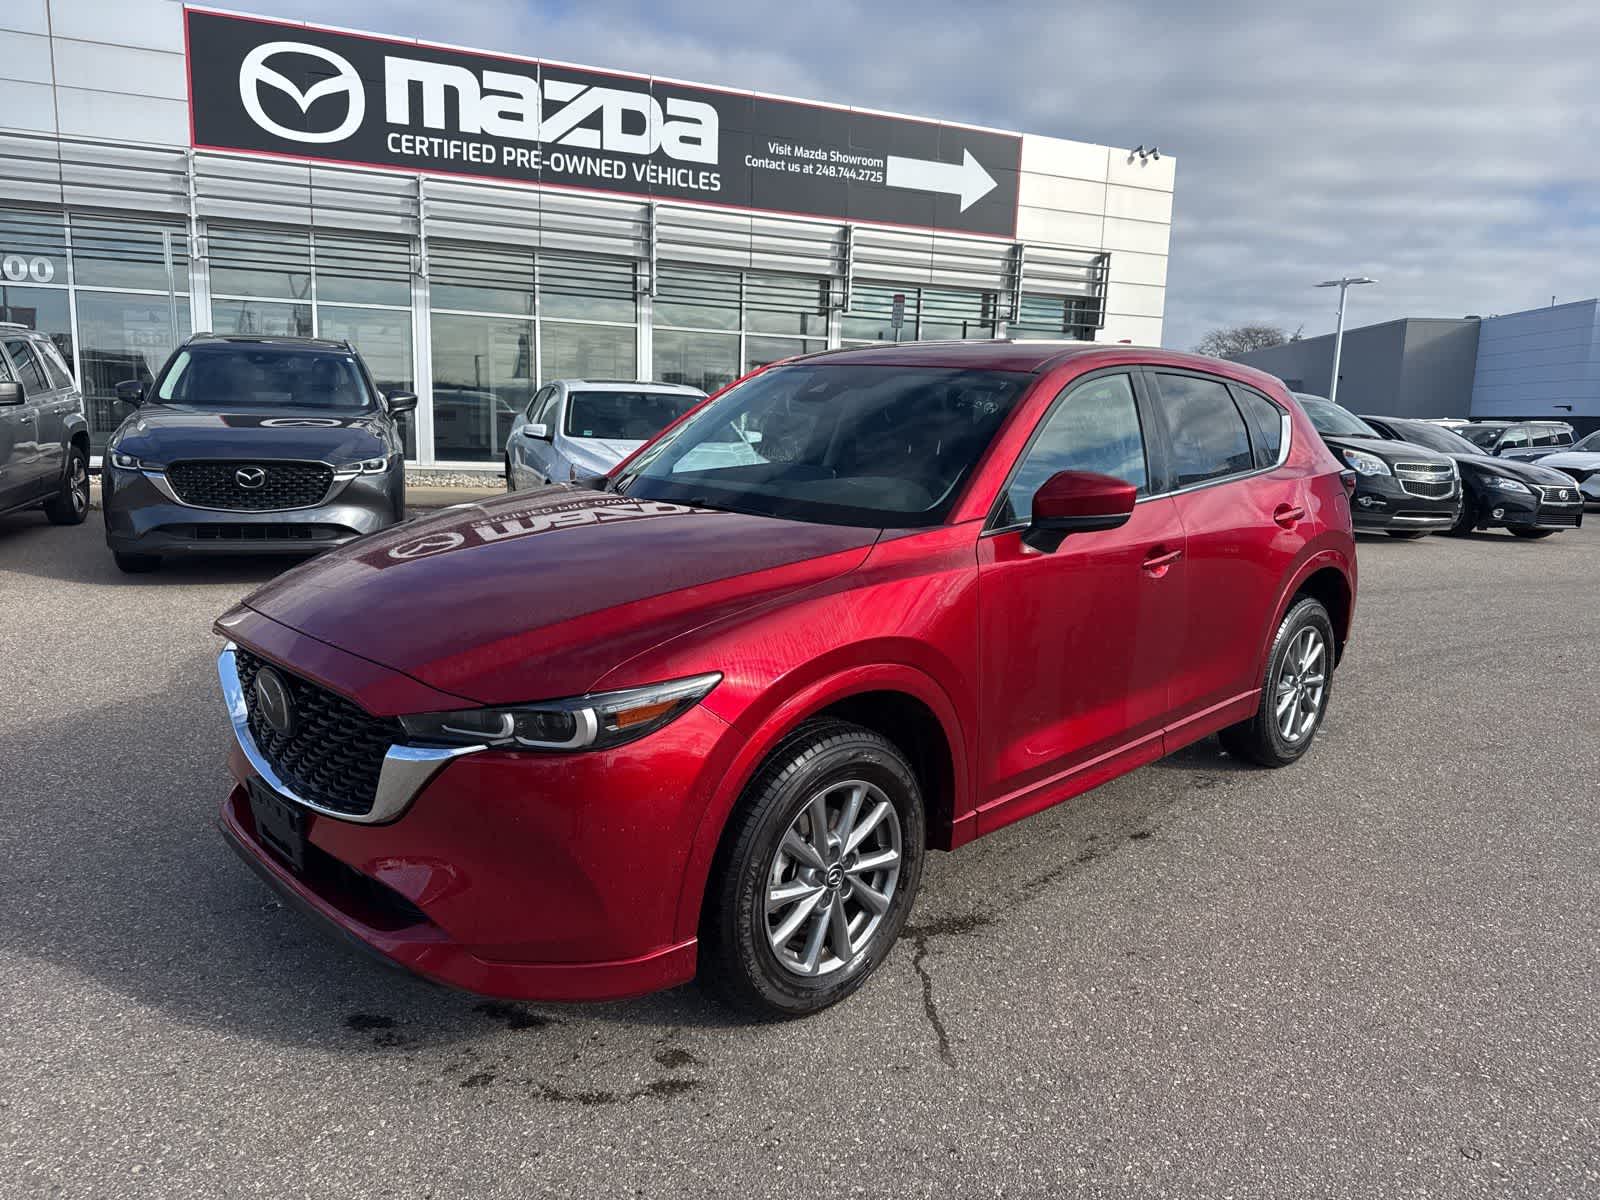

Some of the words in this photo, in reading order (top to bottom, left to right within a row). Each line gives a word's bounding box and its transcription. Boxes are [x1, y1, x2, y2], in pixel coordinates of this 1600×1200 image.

[387, 132, 496, 164] CERTIFIED
[503, 147, 627, 180] PRE-OWNED
[632, 162, 721, 191] VEHICLES
[745, 155, 786, 171] Contact
[788, 162, 801, 173] us
[802, 163, 814, 175] at
[815, 164, 883, 183] 248.744.2725
[768, 142, 792, 156] Visit
[794, 145, 828, 161] Mazda
[830, 150, 884, 168] Showroom
[0, 255, 54, 283] 00
